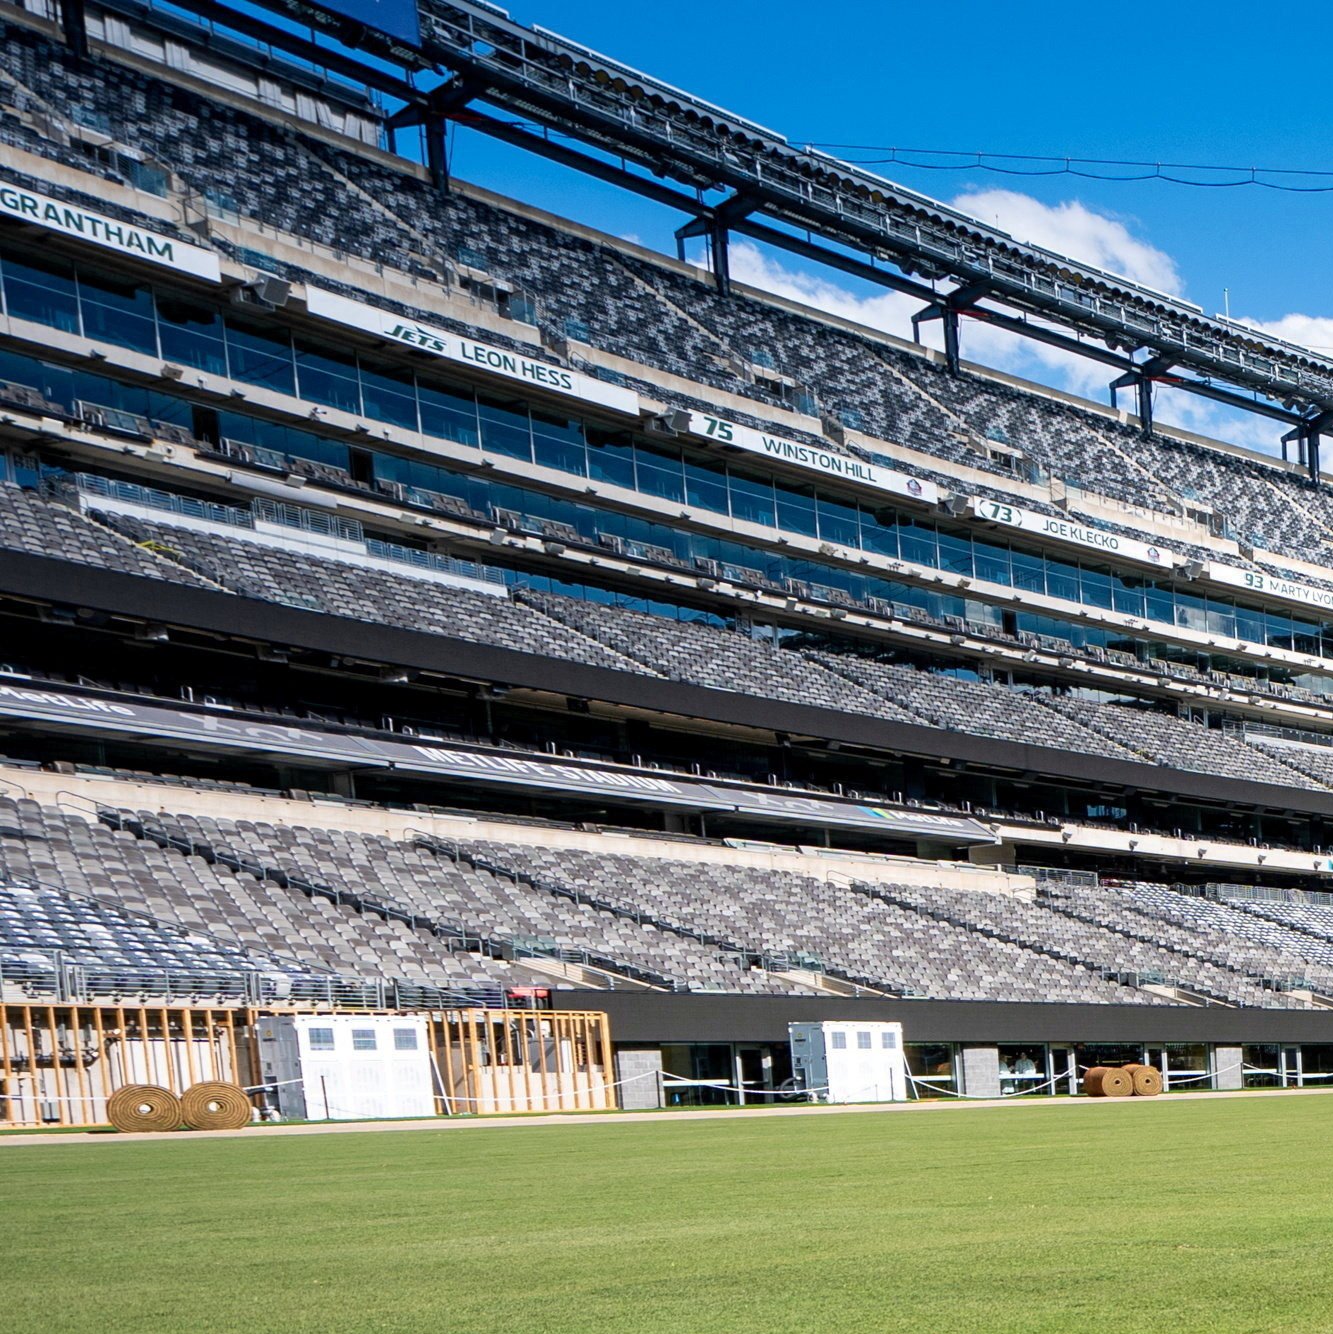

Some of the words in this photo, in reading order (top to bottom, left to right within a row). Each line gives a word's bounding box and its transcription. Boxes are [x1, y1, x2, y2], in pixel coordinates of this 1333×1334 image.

[0, 187, 174, 262] GRANTHAM
[384, 324, 447, 352] JETS
[461, 341, 516, 373] LEON
[522, 361, 572, 390] HESS
[703, 416, 734, 441] 75
[762, 436, 843, 473] WINSTON
[845, 461, 878, 483] HILL
[988, 503, 1013, 523] 73
[1042, 519, 1068, 536] JOE
[1070, 526, 1119, 550] KLECKO
[1244, 573, 1264, 589] 93
[1269, 580, 1310, 602] MARTY
[411, 745, 556, 778] METLIFE
[552, 765, 682, 794] STADIUM
